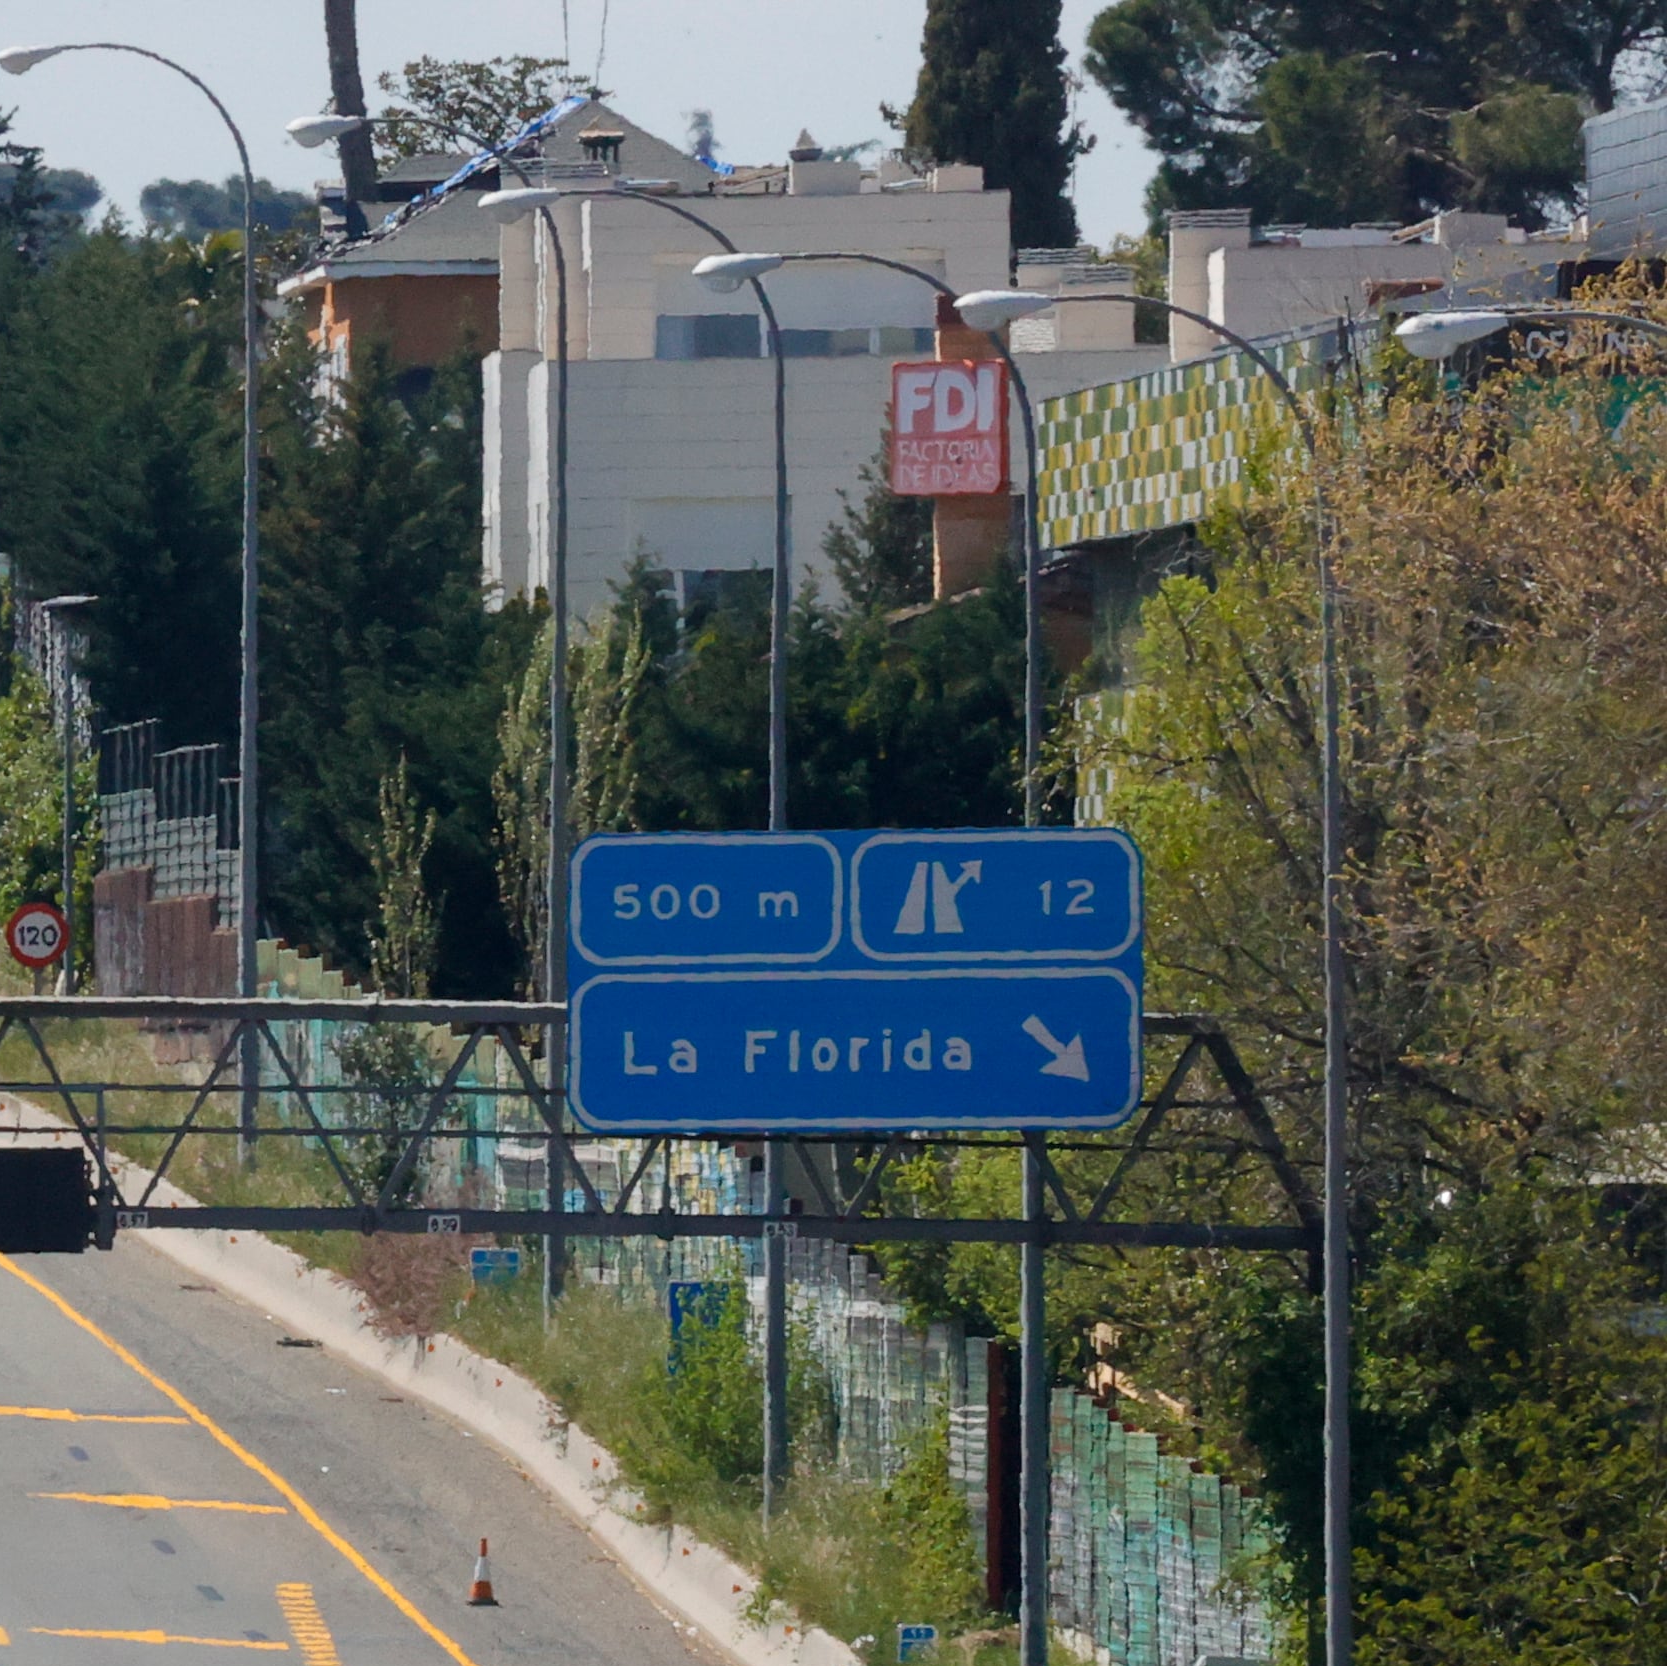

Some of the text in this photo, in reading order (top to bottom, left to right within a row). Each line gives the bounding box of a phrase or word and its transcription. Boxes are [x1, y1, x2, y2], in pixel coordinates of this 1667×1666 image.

[898, 369, 995, 434] FDI
[898, 464, 997, 488] DE IDEAS
[613, 883, 800, 920] 500 m
[1039, 879, 1095, 915] 12
[17, 924, 59, 947] 120
[624, 1028, 973, 1075] La Florida
